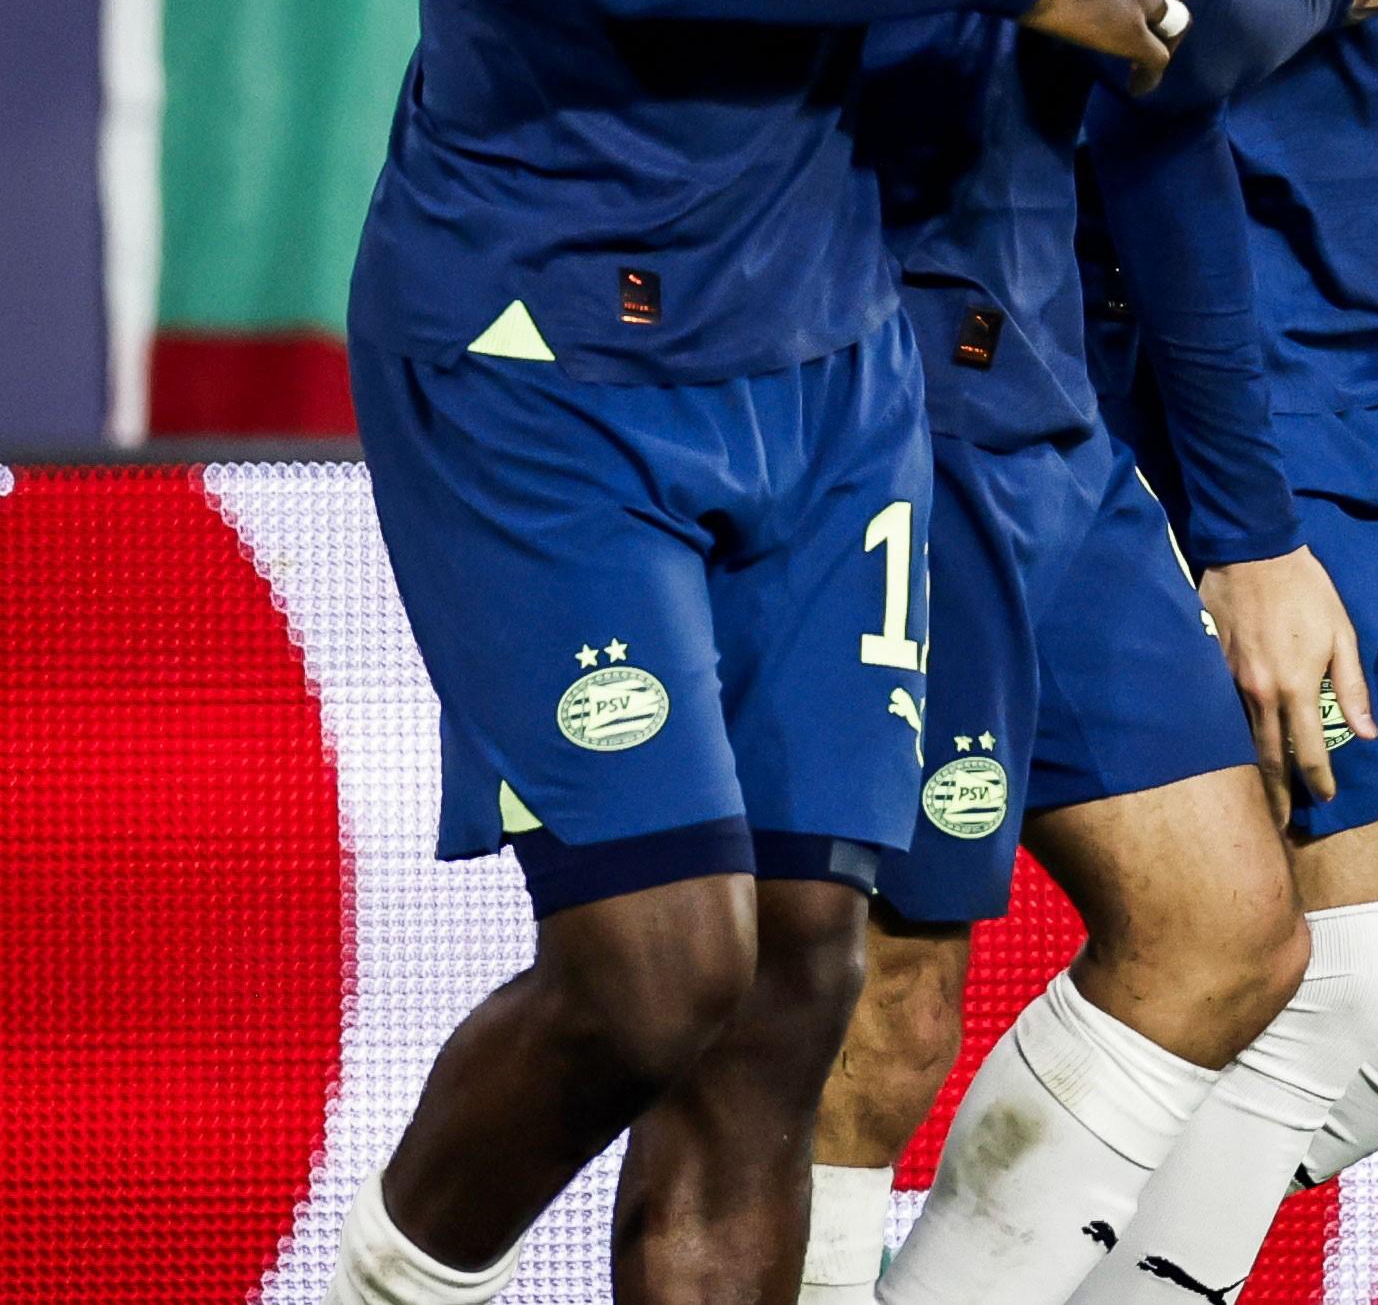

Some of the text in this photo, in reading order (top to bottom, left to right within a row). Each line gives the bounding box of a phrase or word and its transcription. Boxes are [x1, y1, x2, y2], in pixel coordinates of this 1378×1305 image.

[861, 501, 930, 675] 1
[596, 695, 630, 715] PSV
[958, 786, 989, 801] PSV
